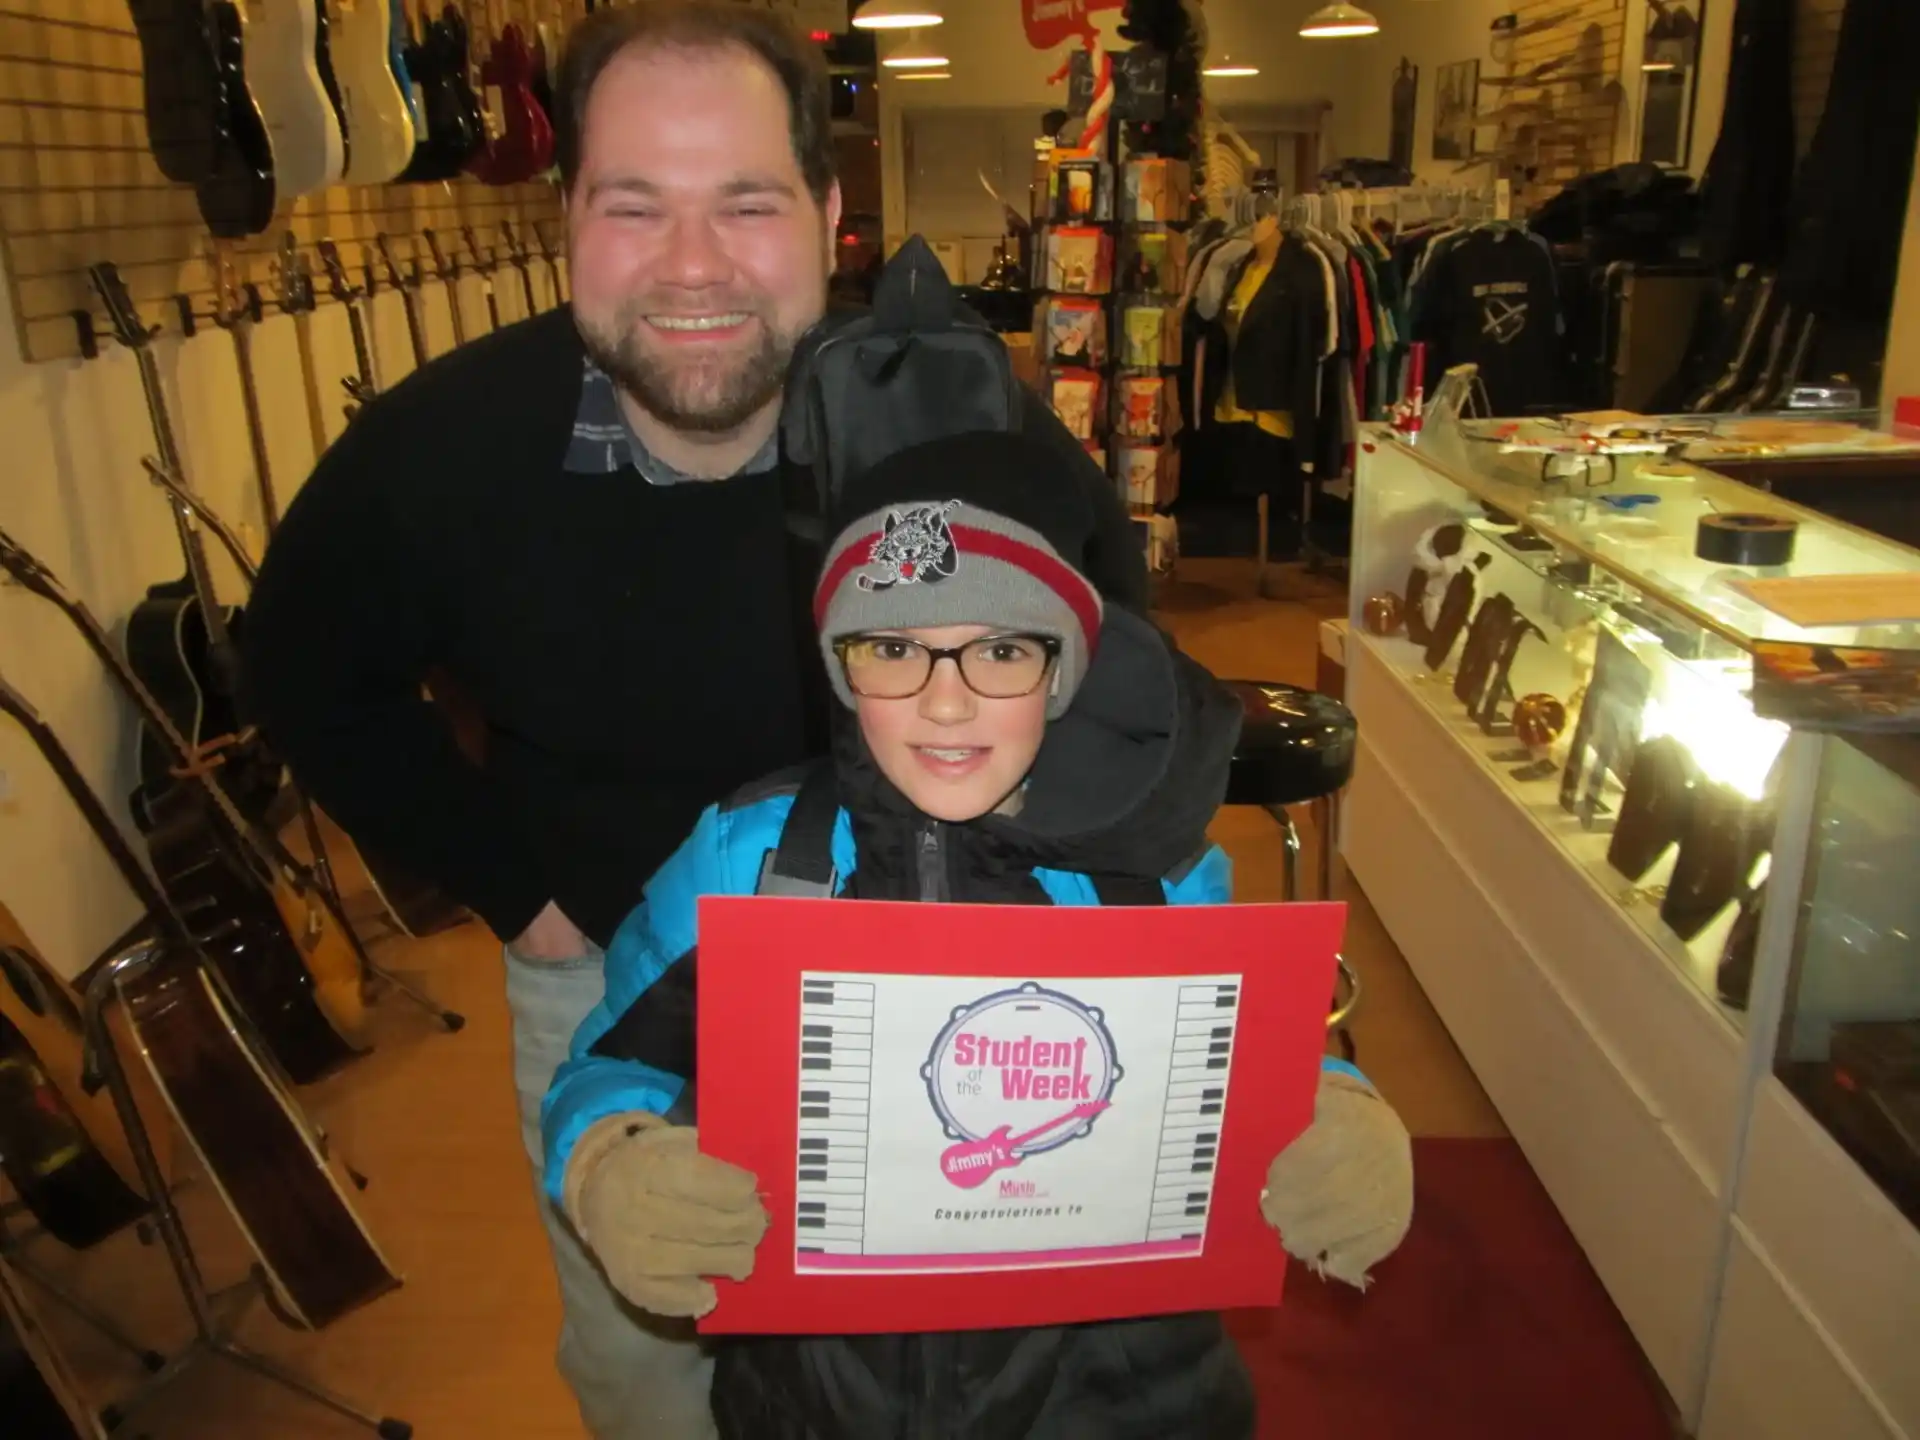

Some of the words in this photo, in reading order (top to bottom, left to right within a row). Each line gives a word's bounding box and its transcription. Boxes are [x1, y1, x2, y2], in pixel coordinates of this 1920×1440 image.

[954, 1033, 1088, 1068] Student
[968, 1069, 983, 1083] of
[1001, 1067, 1092, 1100] Week
[956, 1081, 982, 1096] the
[934, 1207, 1061, 1221] Congratulations
[1068, 1204, 1083, 1216] to
